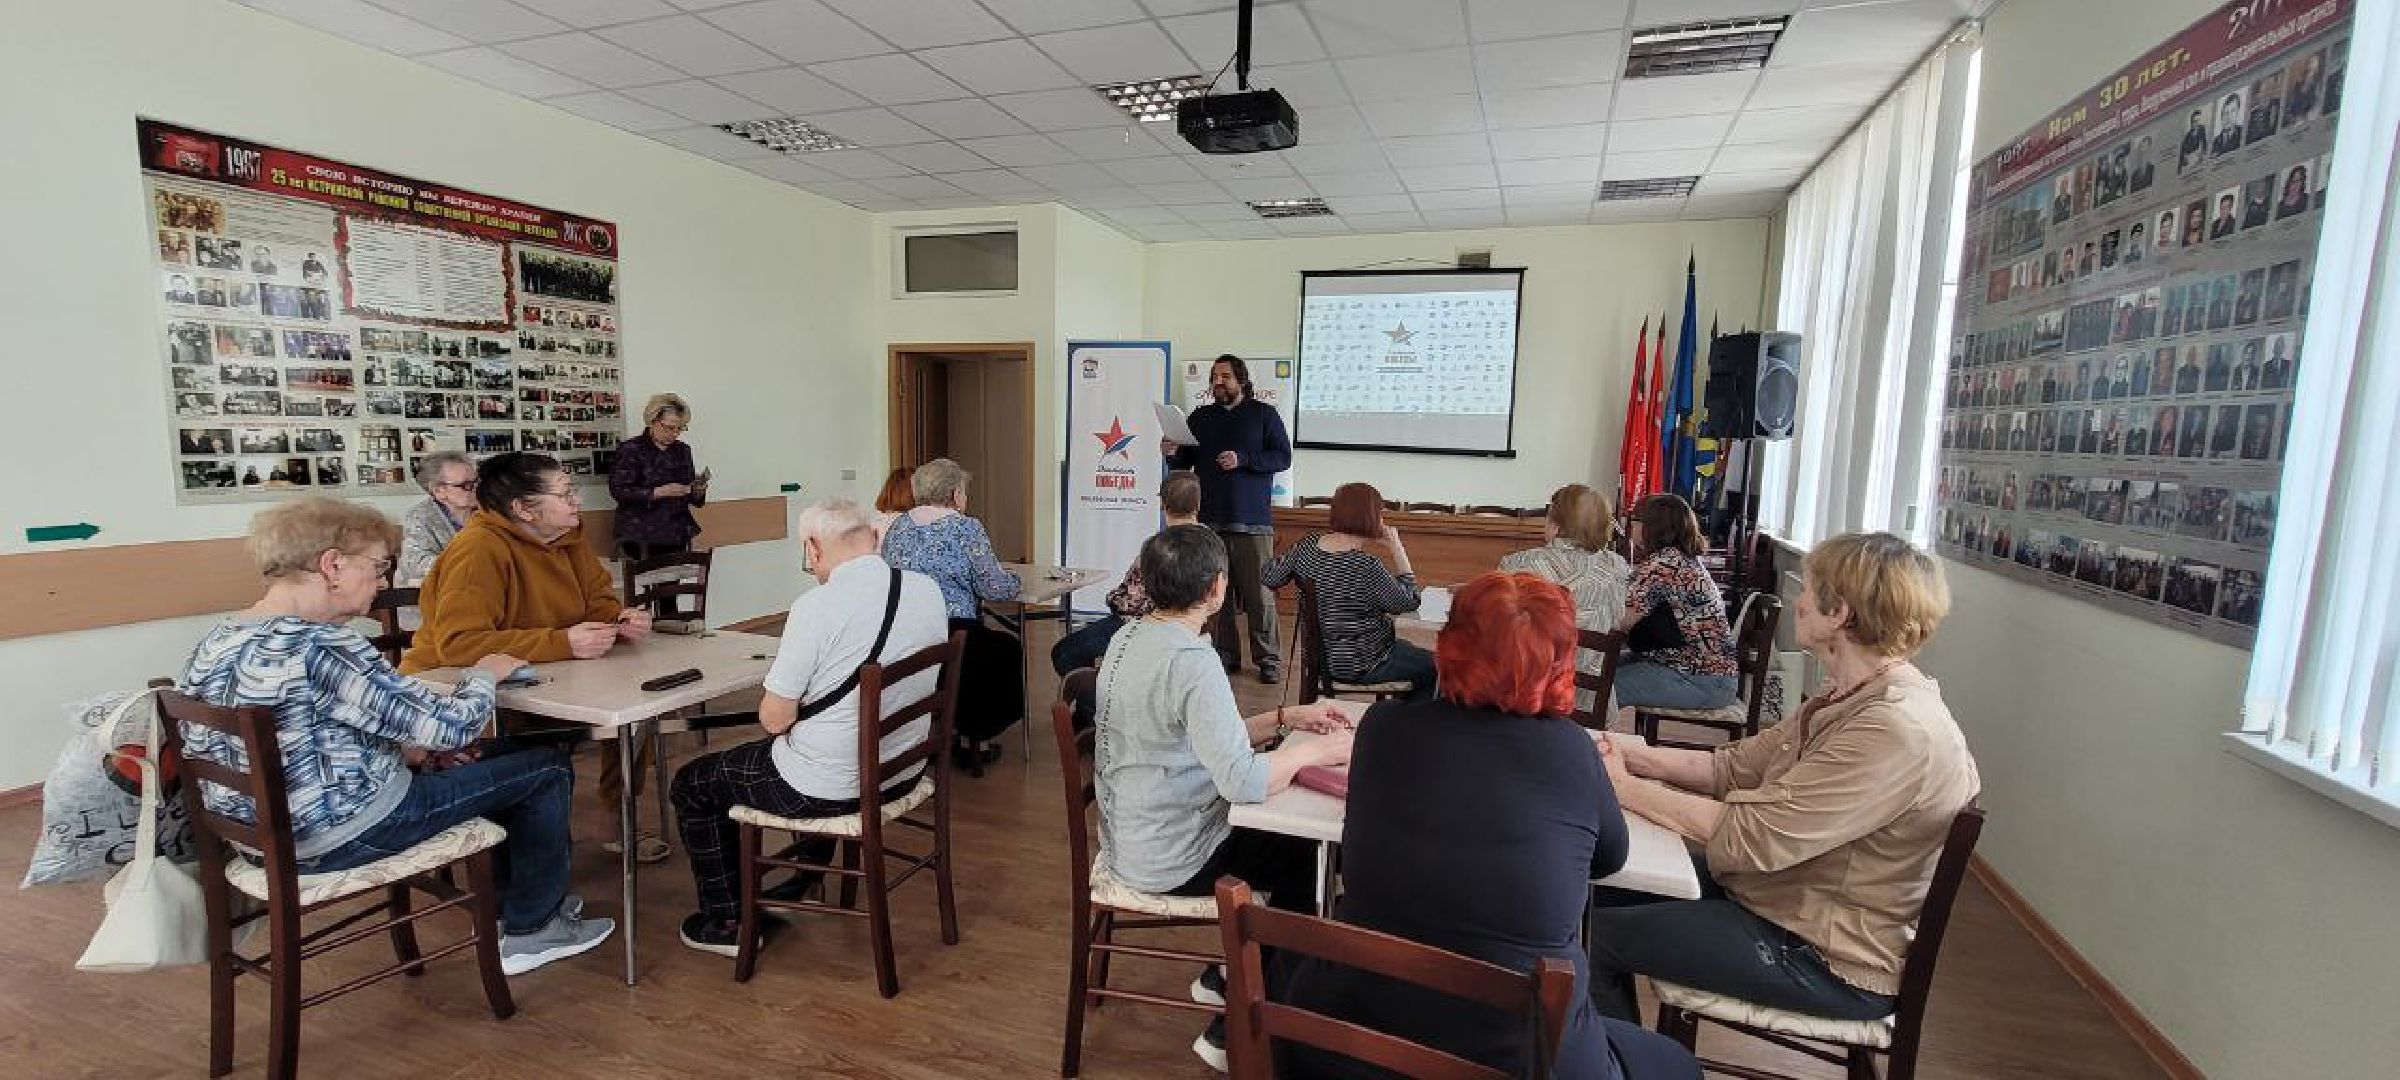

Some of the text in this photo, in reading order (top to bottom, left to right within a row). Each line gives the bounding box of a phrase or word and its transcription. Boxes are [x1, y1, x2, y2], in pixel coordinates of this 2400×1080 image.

[2050, 107, 2087, 141] Нам
[2100, 76, 2129, 109] 30
[2135, 48, 2191, 89] лет.
[225, 145, 261, 181] 1987
[271, 166, 287, 186] 25
